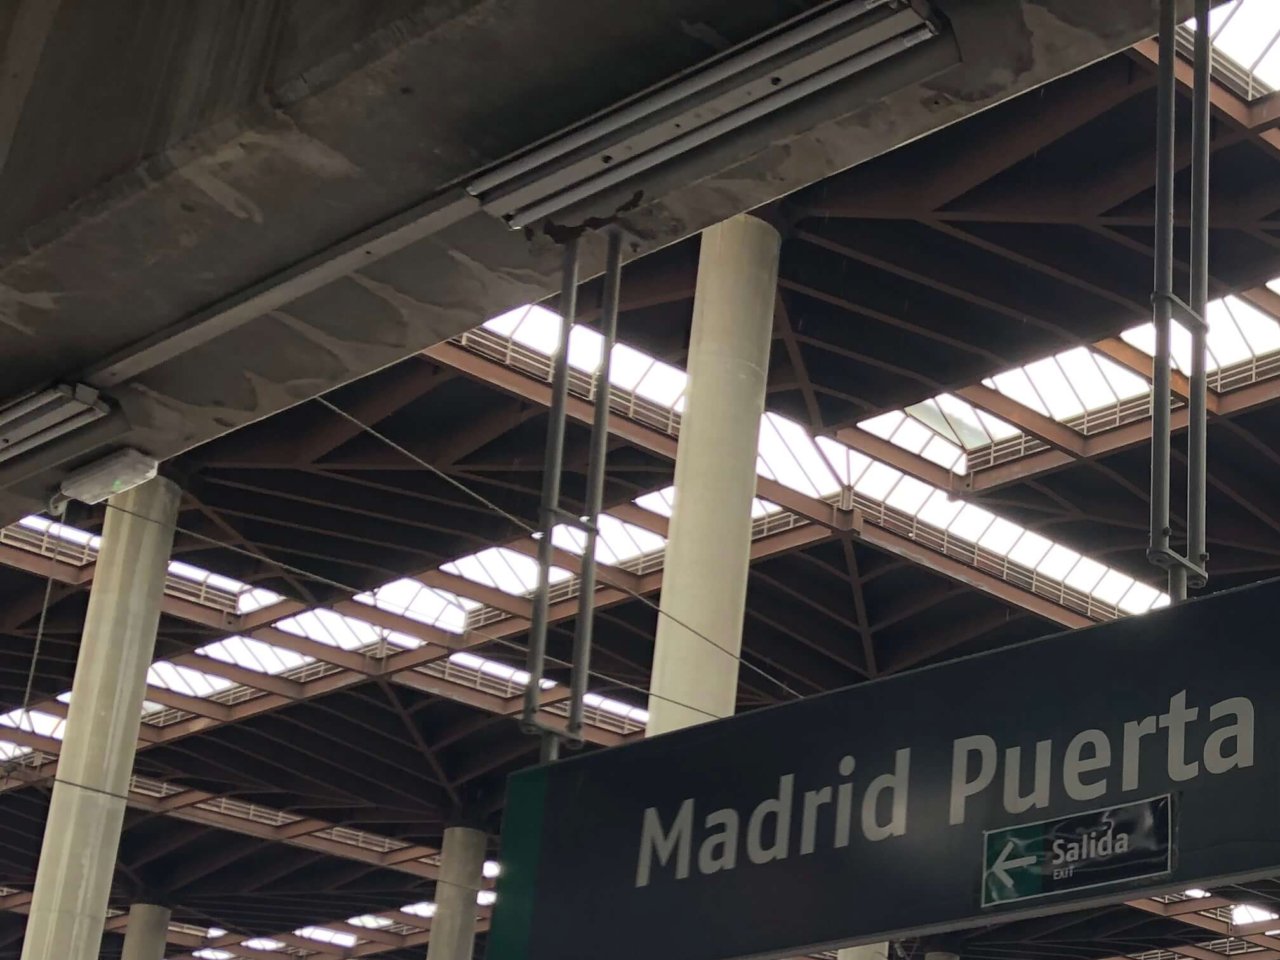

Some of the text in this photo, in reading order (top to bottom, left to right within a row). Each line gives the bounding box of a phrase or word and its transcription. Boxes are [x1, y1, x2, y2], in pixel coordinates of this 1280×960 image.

[635, 748, 911, 888] Madrid
[948, 689, 1255, 827] Puerta
[1052, 828, 1129, 866] Salida
[1052, 865, 1075, 881] EXIT
